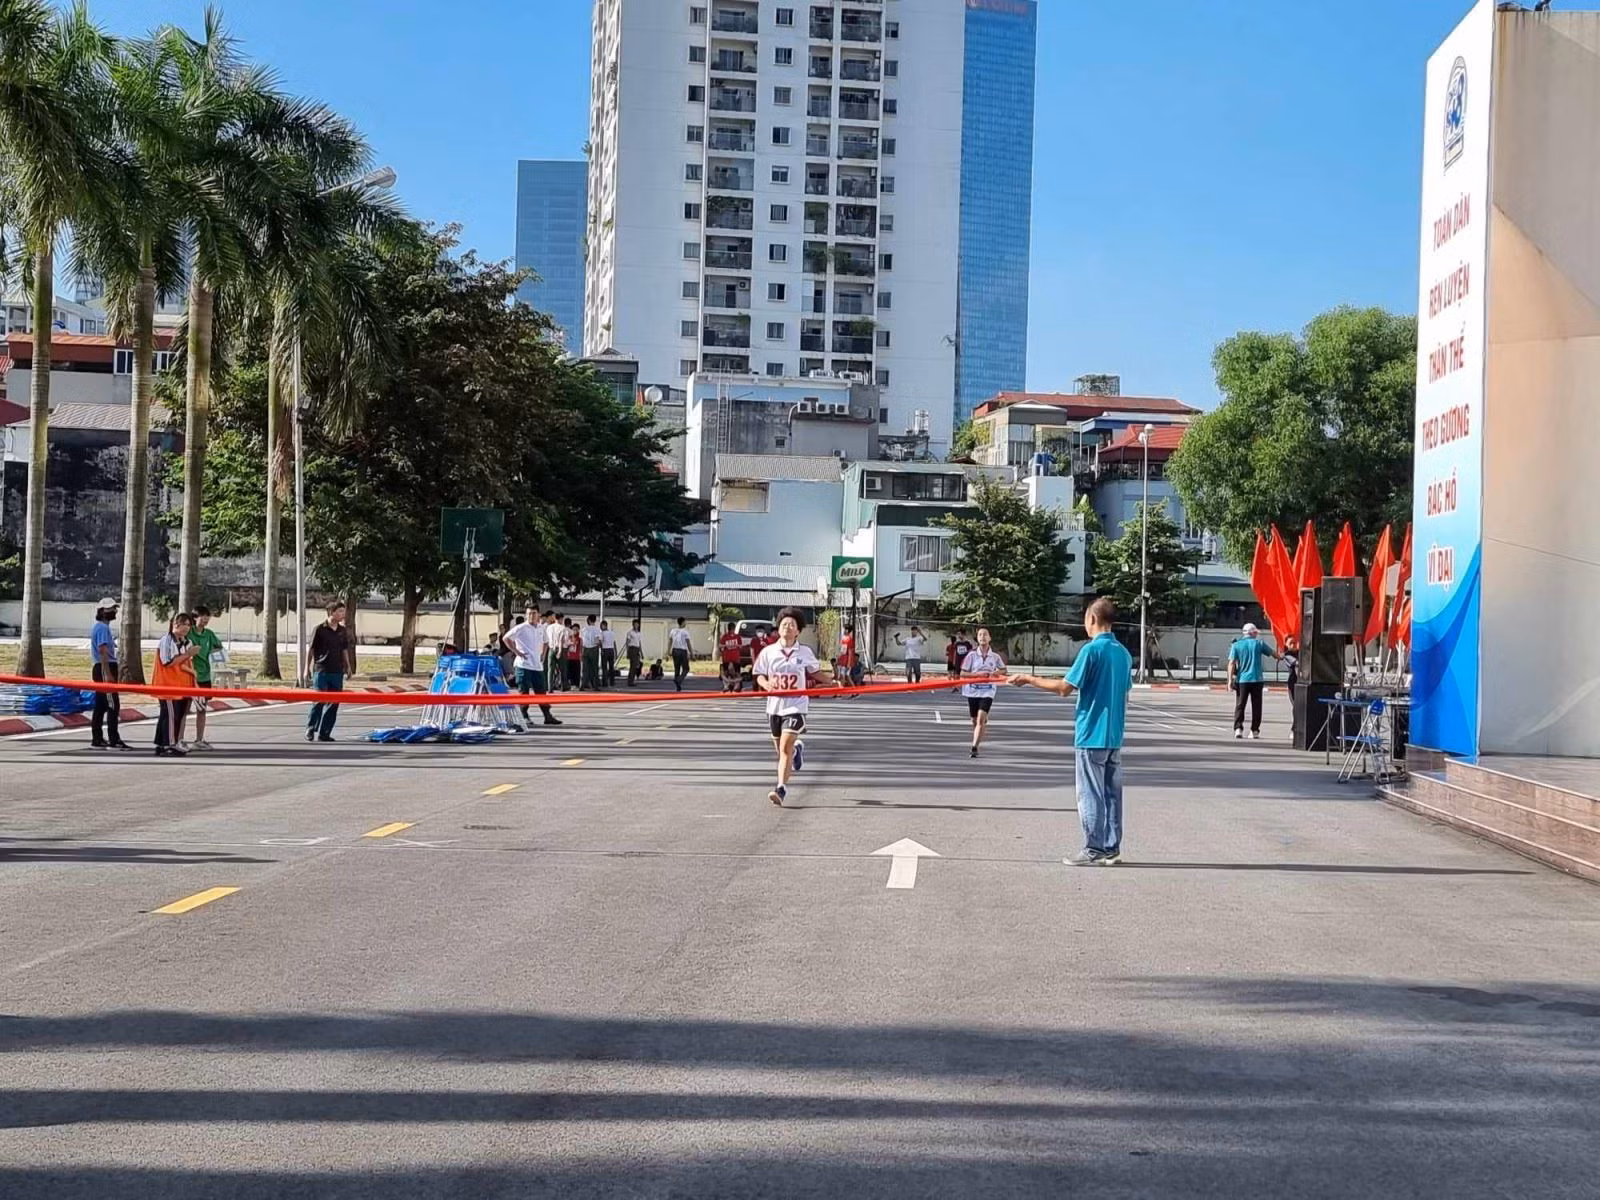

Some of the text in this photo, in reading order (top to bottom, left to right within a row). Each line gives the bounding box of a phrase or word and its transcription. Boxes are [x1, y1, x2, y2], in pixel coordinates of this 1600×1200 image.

[1444, 260, 1470, 309] LUYỆN
[1422, 416, 1439, 453] THEO
[1428, 476, 1442, 516] BÁC
[840, 567, 867, 577] MILO
[1428, 544, 1436, 583] VĨ
[773, 674, 798, 690] 332
